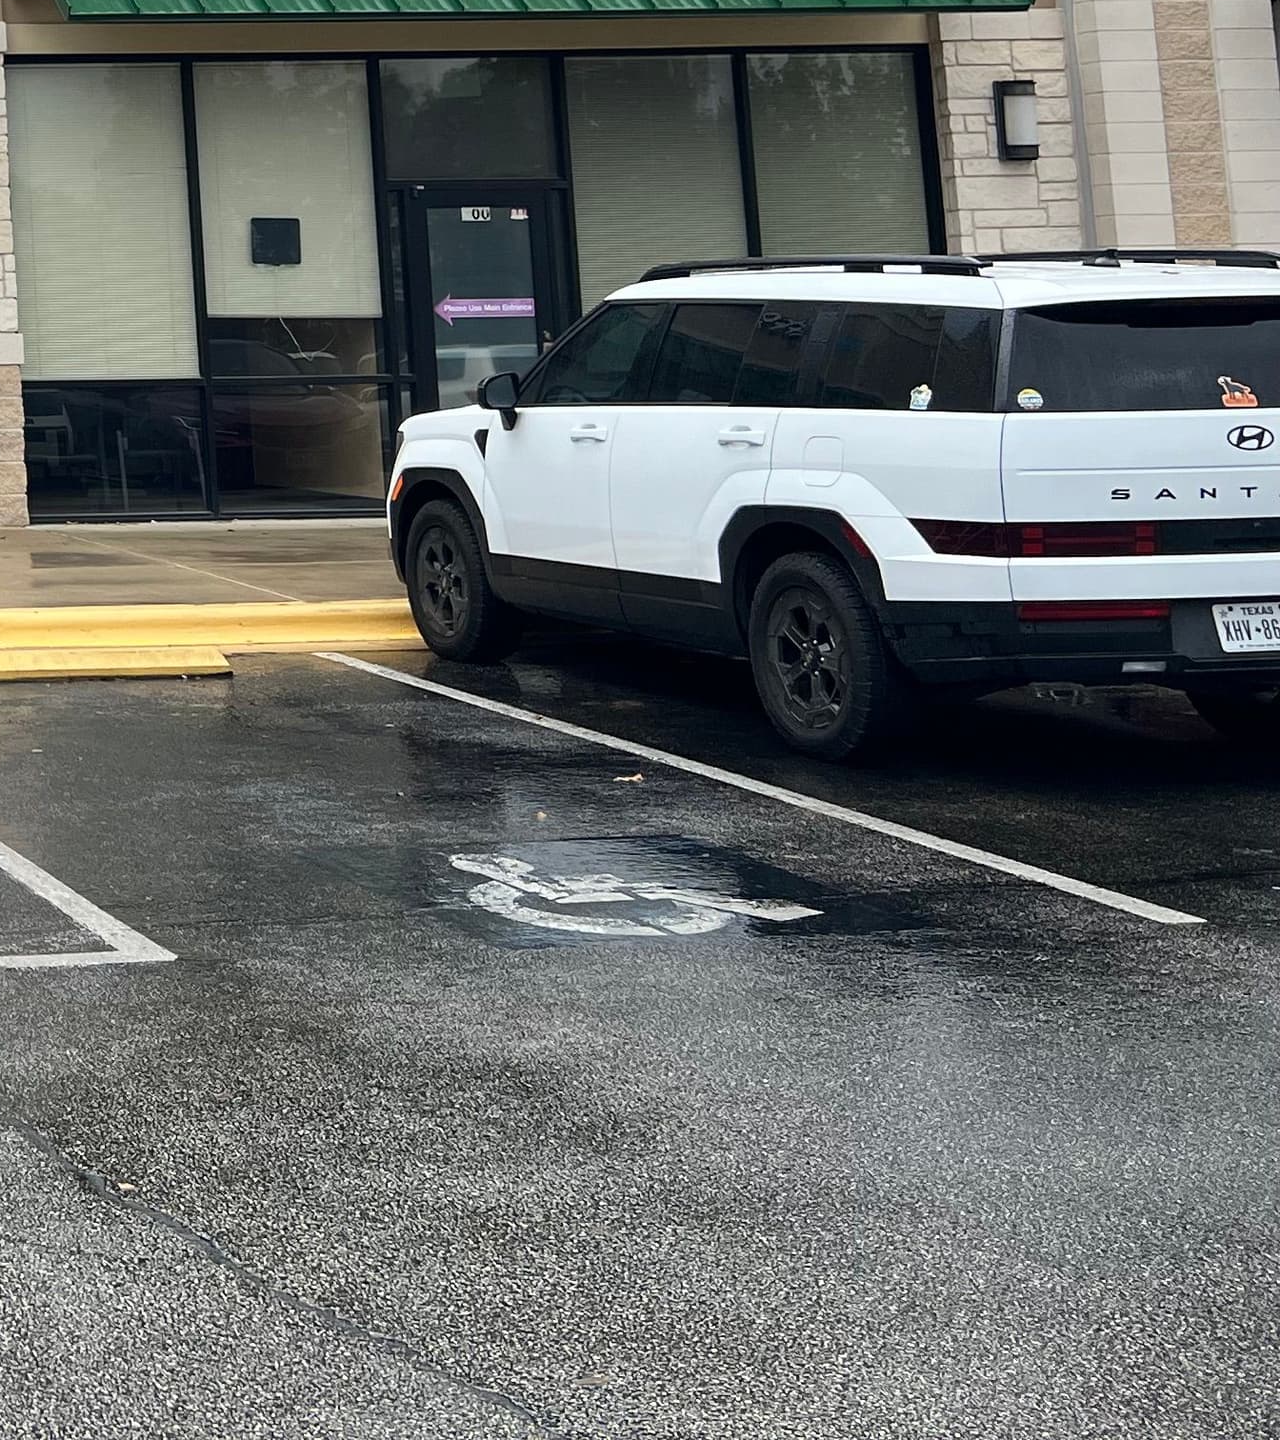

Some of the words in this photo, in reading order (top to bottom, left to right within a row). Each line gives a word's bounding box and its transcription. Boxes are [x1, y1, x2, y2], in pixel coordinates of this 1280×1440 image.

[443, 304, 467, 312] Please
[468, 304, 482, 312] Use
[484, 303, 501, 311] Main
[502, 303, 533, 311] Entrance
[1111, 486, 1280, 500] SANT
[1239, 606, 1274, 616] TEXAS
